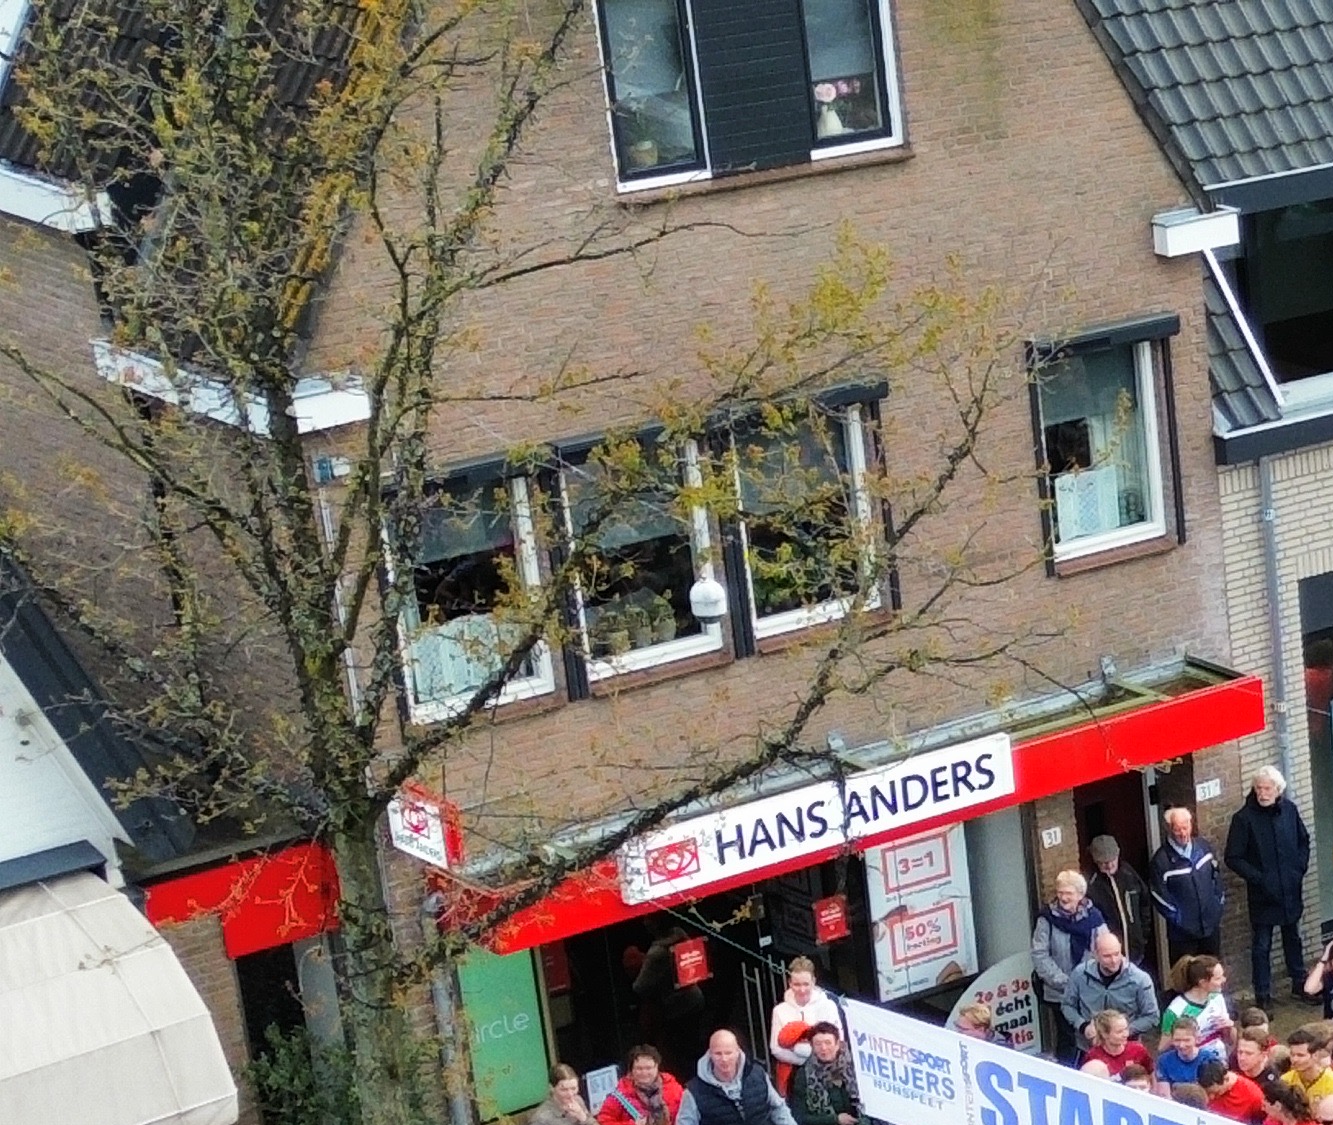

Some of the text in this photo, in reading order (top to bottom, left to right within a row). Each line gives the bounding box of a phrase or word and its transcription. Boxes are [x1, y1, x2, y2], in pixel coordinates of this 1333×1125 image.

[714, 754, 997, 866] HANS ANDERS
[1044, 830, 1058, 847] 31
[897, 850, 934, 876] 3=1
[904, 917, 942, 940] 50%
[868, 1033, 951, 1075] INTERSPORT
[858, 1050, 956, 1101] MEIJERS
